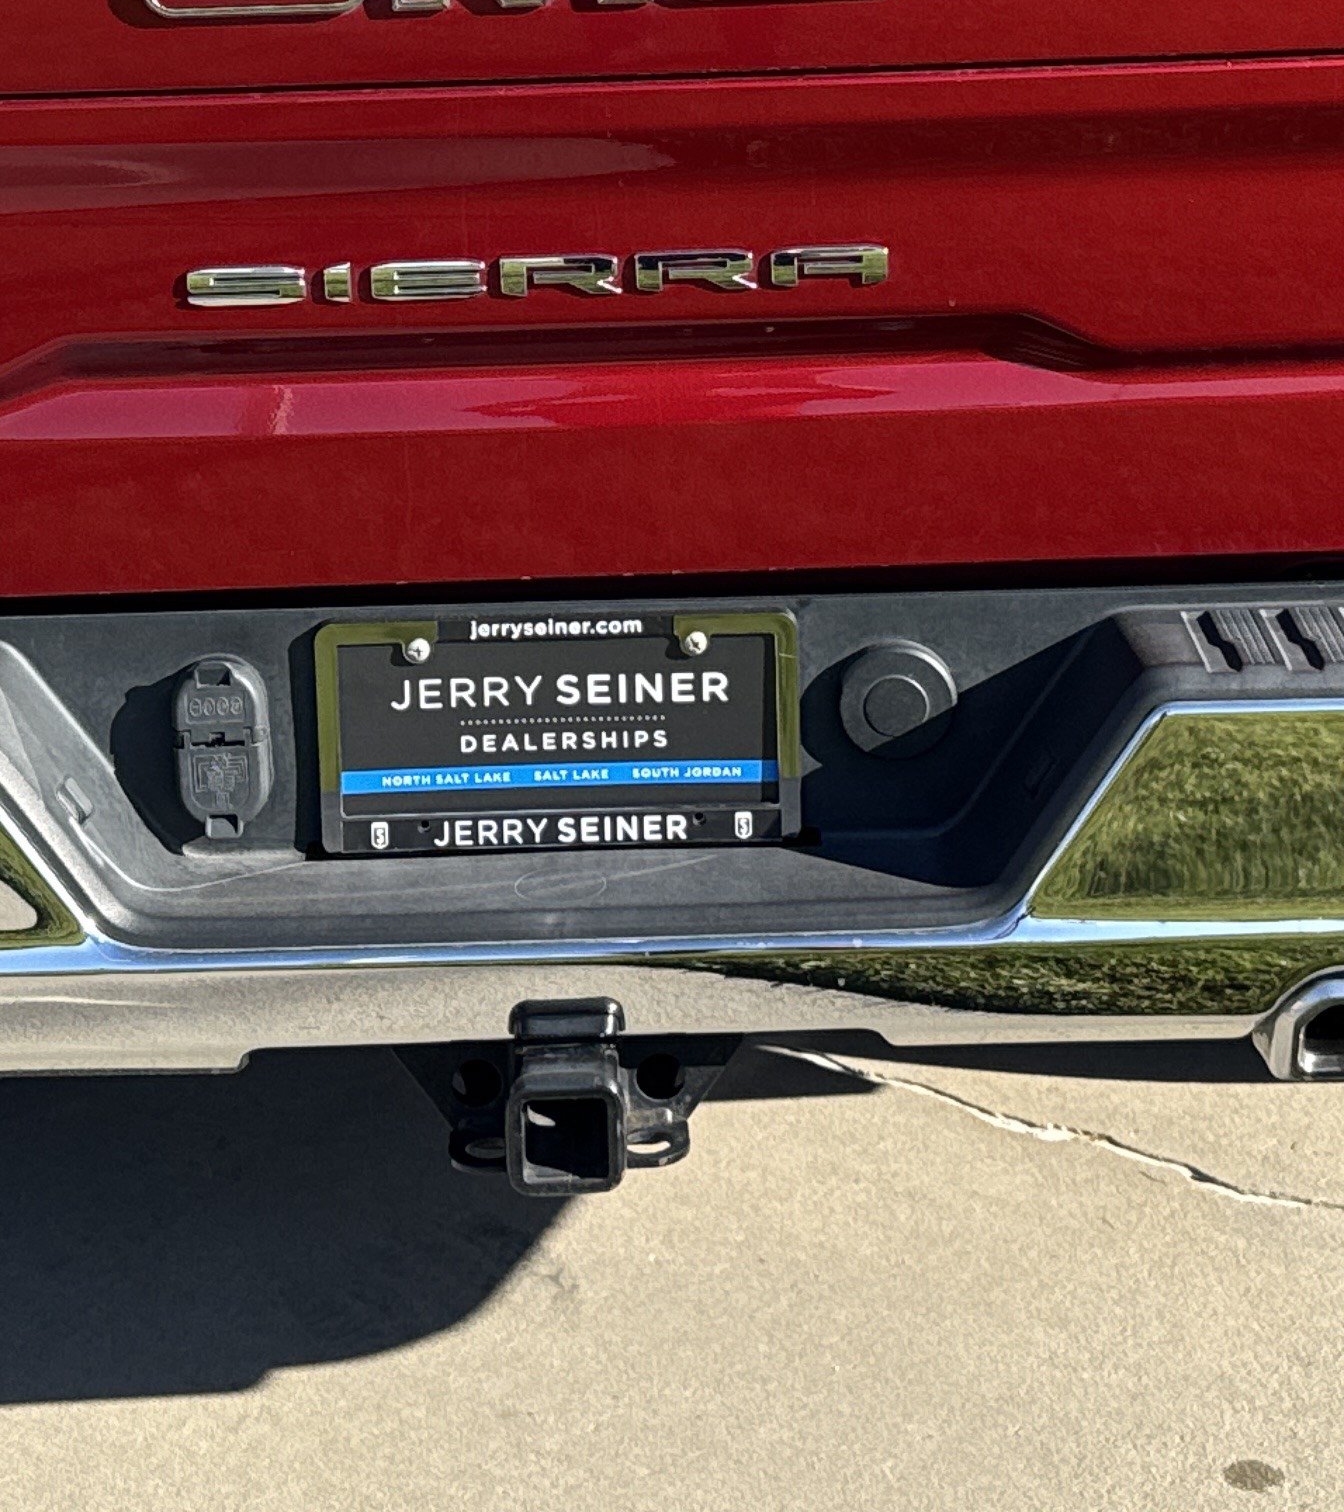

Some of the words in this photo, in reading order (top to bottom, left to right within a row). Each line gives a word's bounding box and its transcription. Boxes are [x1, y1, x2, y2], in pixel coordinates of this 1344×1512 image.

[186, 244, 890, 306] SIERRA
[469, 618, 643, 641] jerryseiner.com
[391, 675, 543, 711] JERRY
[556, 671, 730, 706] SEINER
[460, 730, 668, 754] DEALERSHIPS
[382, 774, 431, 787] NORTH
[435, 772, 469, 784] SALT
[475, 771, 511, 783] LAKE
[534, 770, 568, 781] SALT
[573, 768, 609, 781] LAKE
[632, 766, 679, 779] SOUTH
[684, 765, 742, 777] JORDAN
[434, 817, 548, 847] JERRY
[558, 814, 687, 843] SEINER
